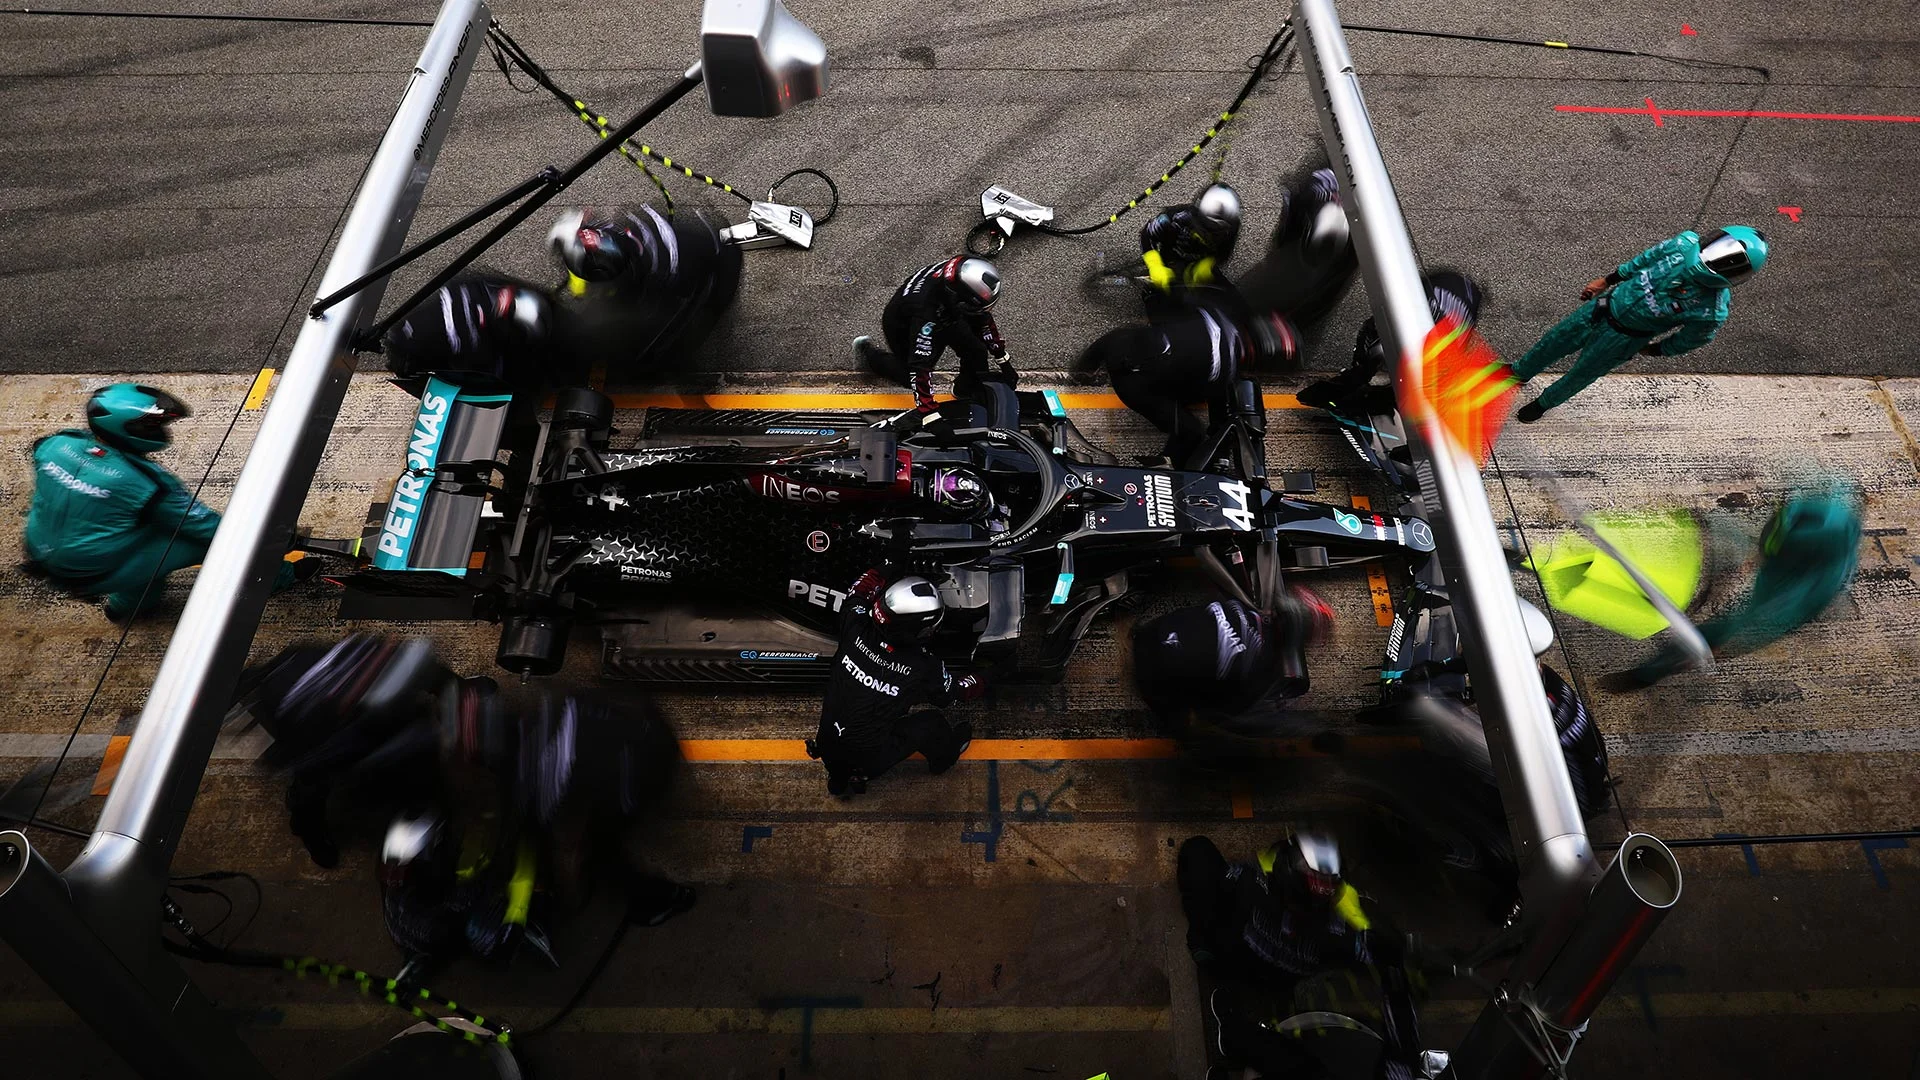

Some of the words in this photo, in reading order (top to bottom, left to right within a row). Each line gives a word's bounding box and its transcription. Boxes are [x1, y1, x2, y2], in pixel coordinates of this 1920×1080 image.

[43, 461, 113, 499] PETRONAS
[378, 391, 447, 558] PETRONAS
[762, 474, 840, 504] INEOS
[1144, 474, 1157, 528] PETRONAS
[1154, 474, 1176, 528] SYNTIUM
[1218, 480, 1255, 532] 44
[621, 565, 672, 579] PETRONAS
[740, 650, 757, 659] EQ
[759, 651, 819, 659] PERFORMANCE
[841, 654, 900, 697] PETRONAS
[854, 636, 912, 677] Mercedes-AMG
